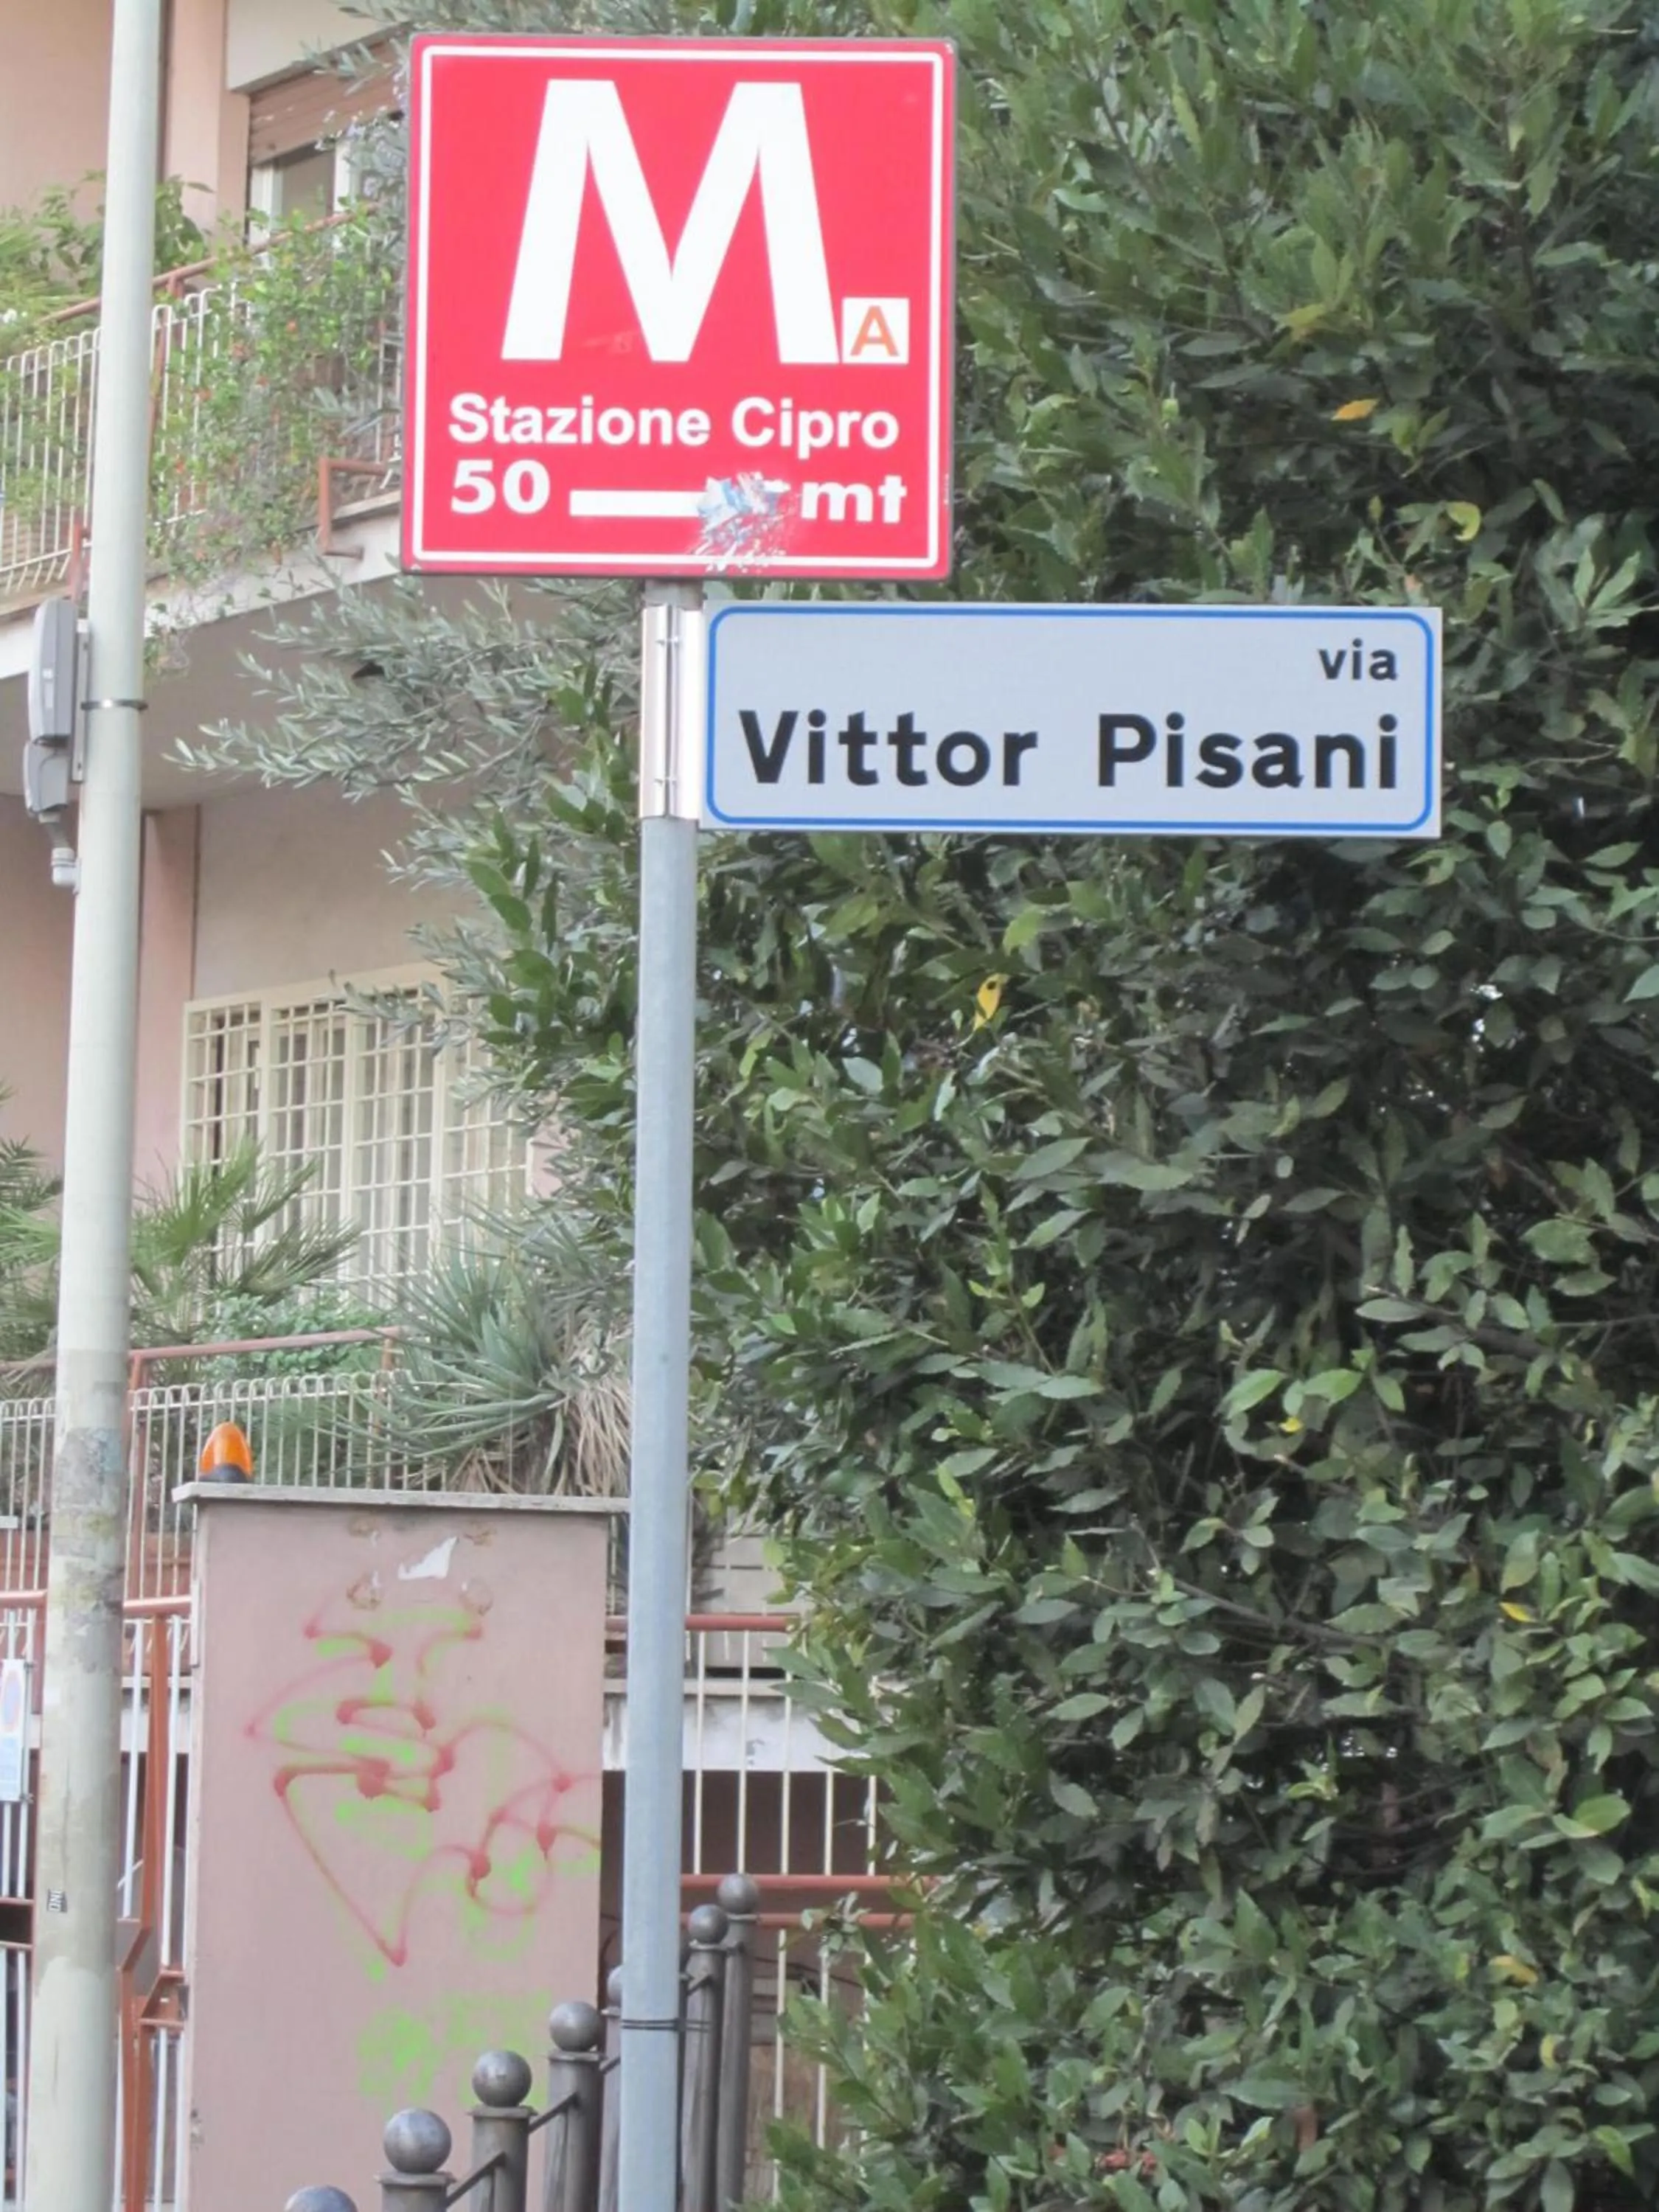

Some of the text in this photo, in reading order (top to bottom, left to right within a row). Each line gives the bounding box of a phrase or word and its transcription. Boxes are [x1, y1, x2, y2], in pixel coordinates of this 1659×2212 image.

[501, 78, 841, 364] M
[850, 305, 899, 357] A
[448, 392, 899, 460] Stazione Cipro
[451, 459, 907, 524] 50 mt
[1318, 638, 1398, 681] via
[739, 709, 1398, 790] Vittor Pisani
